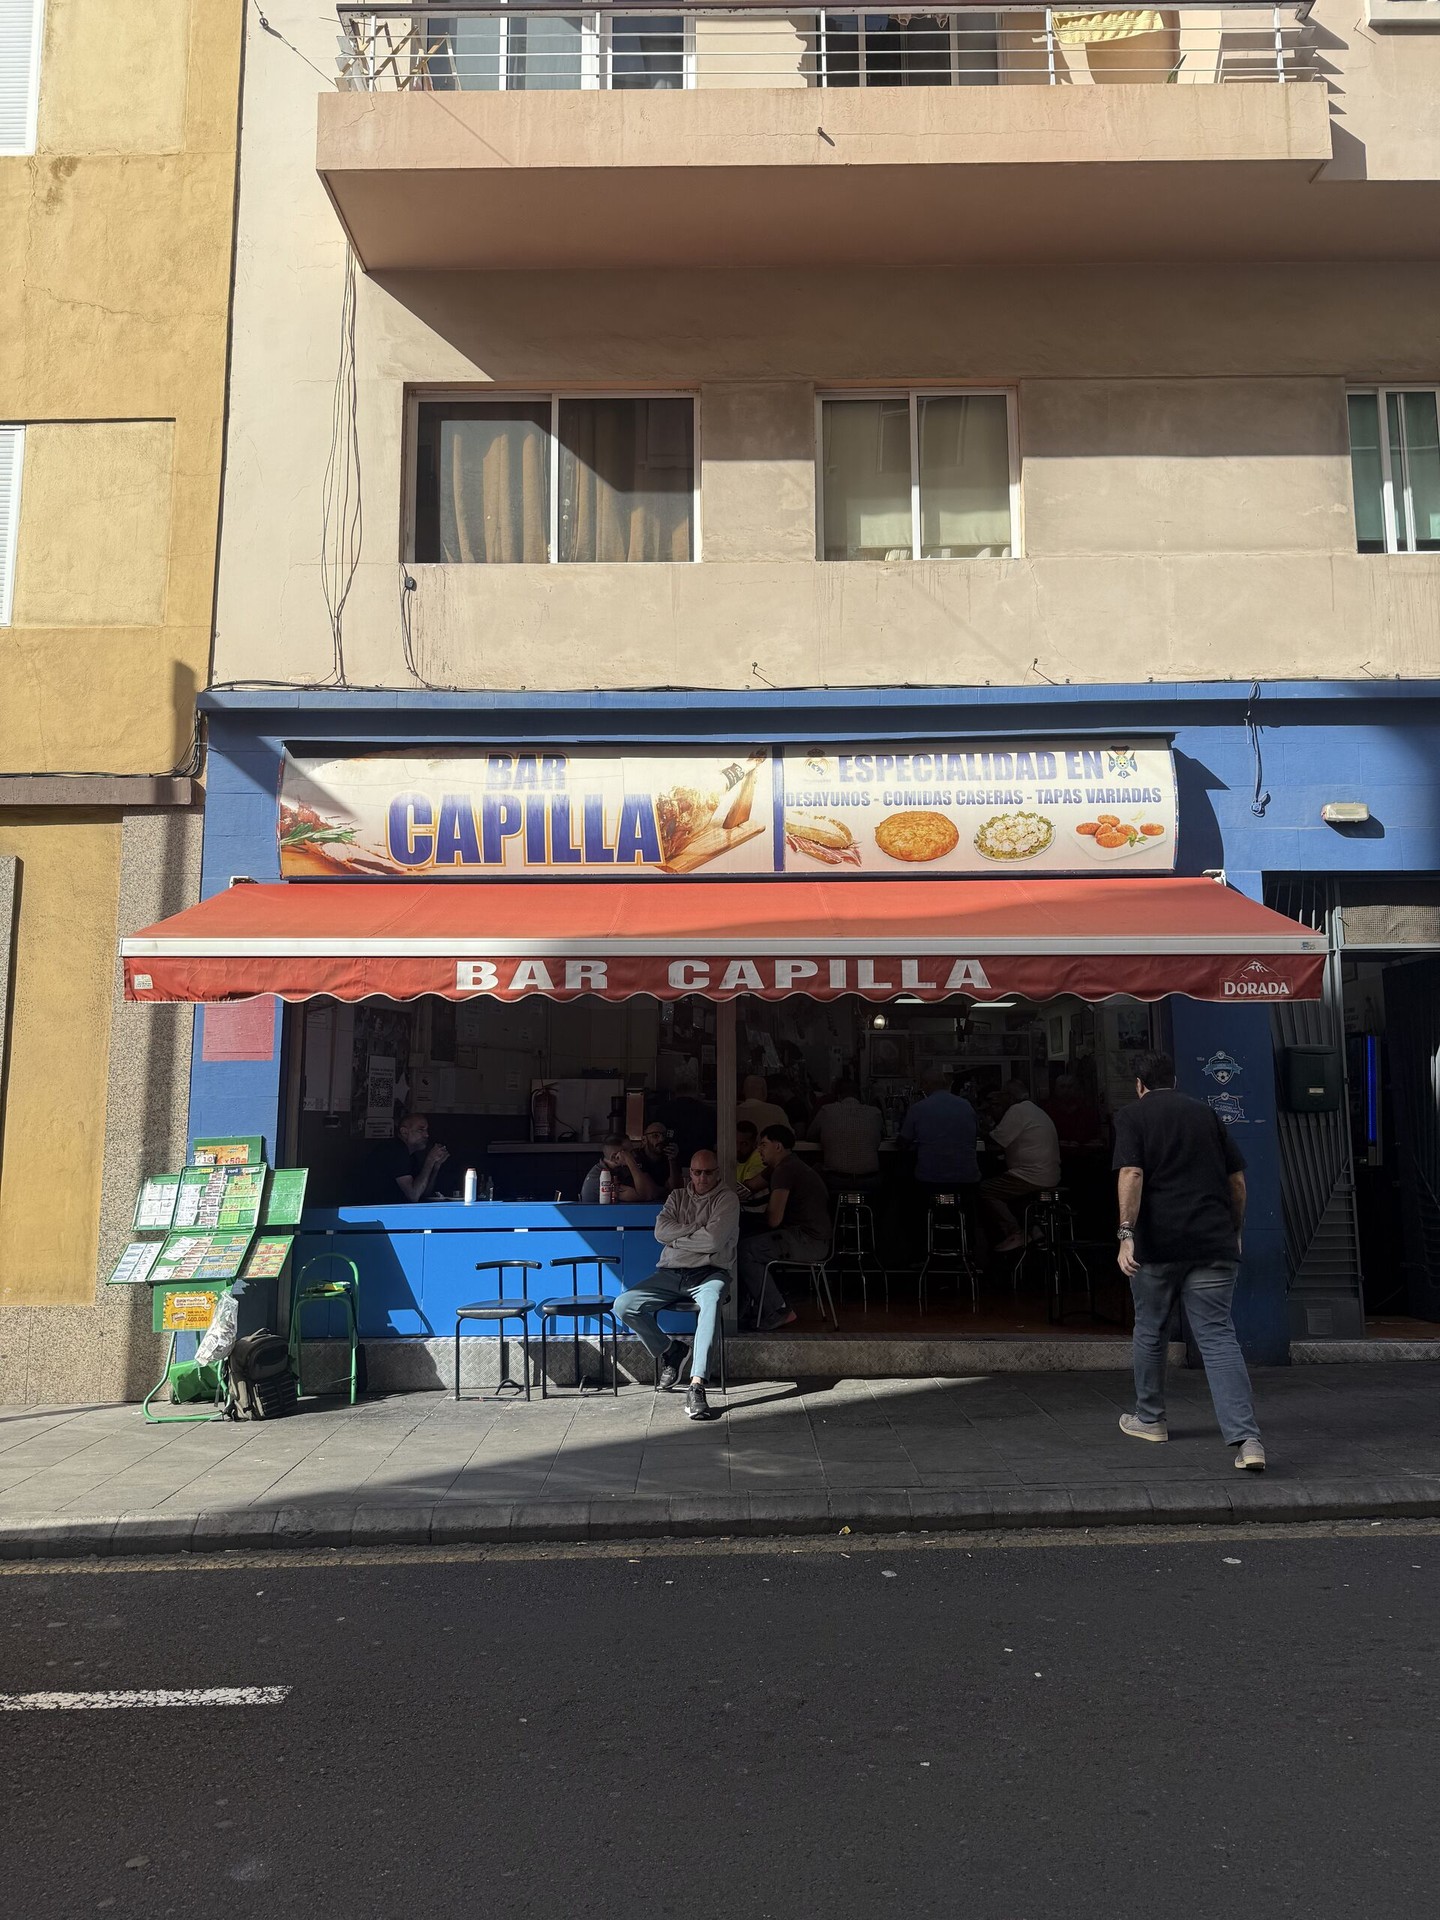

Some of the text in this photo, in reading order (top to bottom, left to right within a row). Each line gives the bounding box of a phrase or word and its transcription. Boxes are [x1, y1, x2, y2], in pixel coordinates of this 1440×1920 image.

[486, 752, 568, 790] BAR
[839, 752, 1057, 782] ESPECIALIDAD
[1066, 751, 1105, 779] EN
[786, 791, 870, 807] DESAYUNOS
[883, 790, 952, 806] COMIDAS
[956, 789, 1023, 805] CASERAS
[1036, 788, 1082, 804] TAPAS
[1085, 787, 1162, 803] VARIADAS
[388, 791, 665, 866] CAPILLA
[456, 960, 992, 991] BAR CAPILLA
[1224, 981, 1290, 995] DORADA
